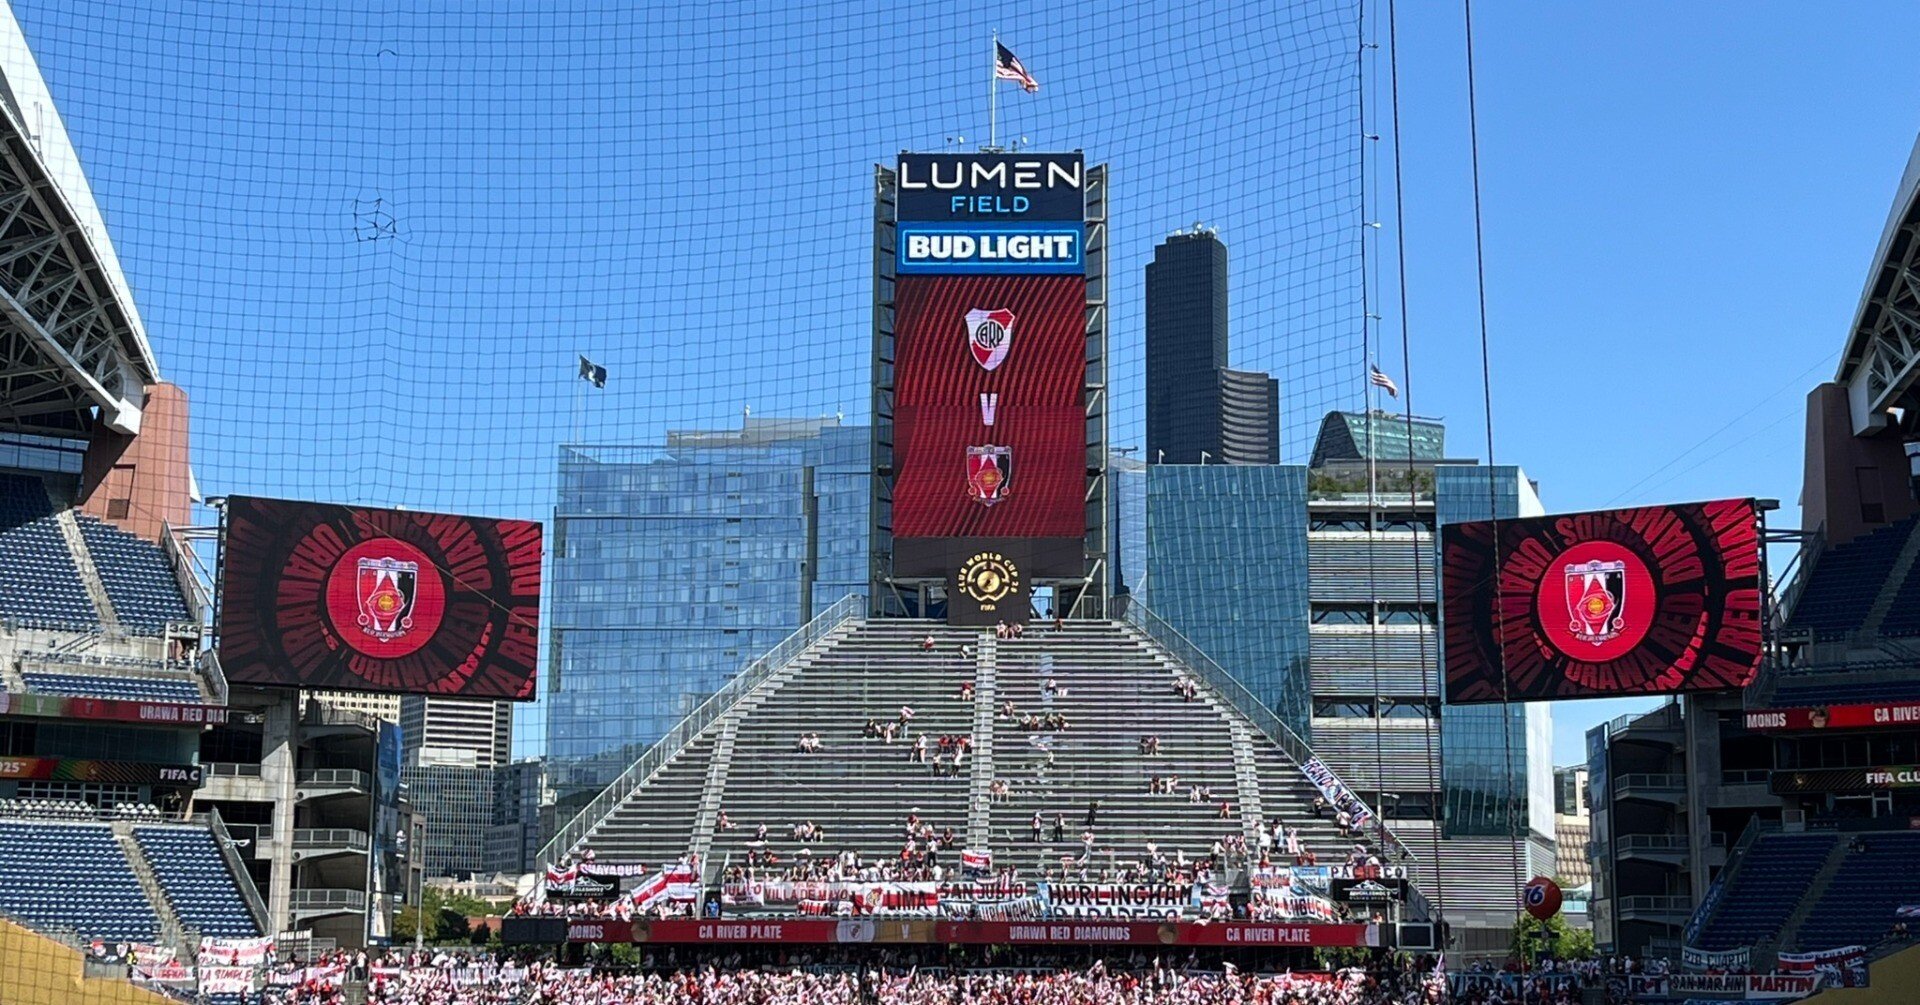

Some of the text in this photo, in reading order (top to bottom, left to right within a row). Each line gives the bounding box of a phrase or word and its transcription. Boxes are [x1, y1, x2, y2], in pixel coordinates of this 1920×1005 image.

[901, 161, 1080, 189] LUMEN
[951, 196, 1029, 213] FIELD
[908, 235, 976, 259] BUD
[979, 393, 998, 426] V
[965, 552, 1003, 567] WORLD
[1003, 559, 1019, 578] CUP
[980, 604, 996, 612] FIFA
[349, 649, 450, 690] URAWA
[1565, 650, 1670, 690] URAWA
[140, 705, 178, 721] URAWA
[182, 707, 203, 722] RED
[1747, 713, 1787, 729] MONDS
[1874, 708, 1890, 722] CA
[159, 768, 188, 781] FIFA
[1866, 772, 1895, 785] FIFA
[1048, 884, 1193, 906] HURLINGHAM
[1524, 885, 1545, 906] 76
[700, 924, 782, 940] CA RIVER PLATE
[902, 924, 909, 939] V
[1009, 926, 1131, 941] URAWA RED DIAMONDS
[1226, 927, 1310, 943] CA RIVER PLATE
[1750, 976, 1815, 992] MARTIN
